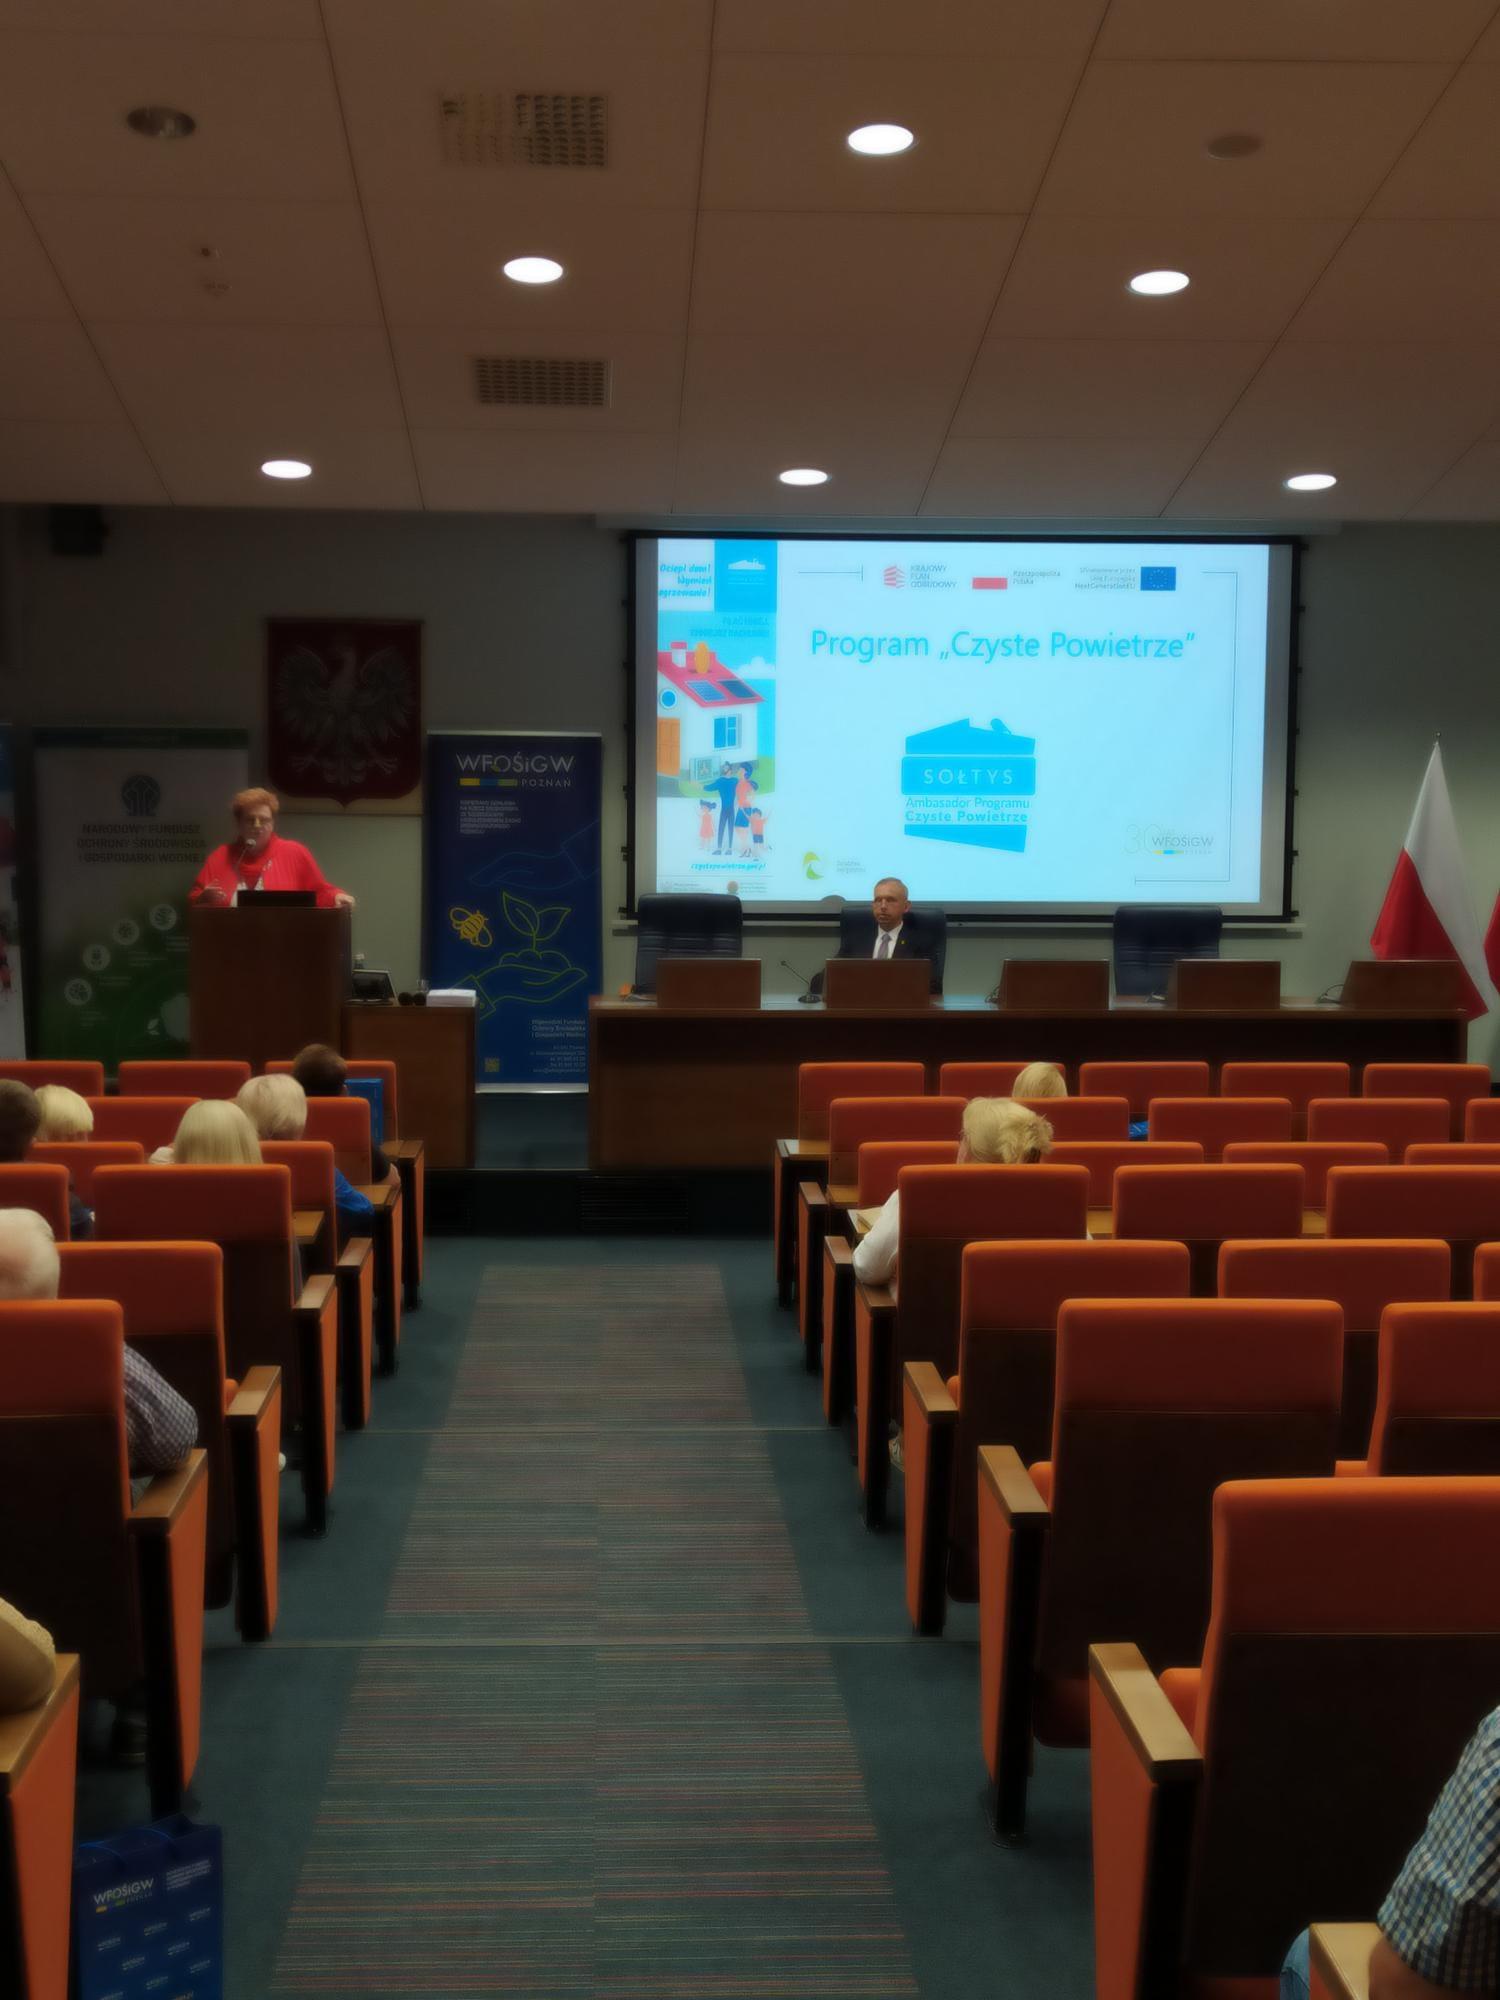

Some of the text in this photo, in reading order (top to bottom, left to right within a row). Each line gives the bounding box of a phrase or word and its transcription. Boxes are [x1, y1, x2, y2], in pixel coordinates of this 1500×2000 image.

[910, 564, 947, 573] KRAJOWY
[811, 630, 930, 663] Program
[939, 631, 1041, 664] „Czyste
[455, 751, 575, 773] WFOŚiGW
[520, 777, 572, 788] POZNAŃ
[923, 768, 1014, 785] SOŁTYS
[905, 797, 1030, 811] Ambasador Programu
[905, 810, 1029, 824] Czyste Powietrze
[81, 823, 201, 834] NARODOWY FUNDUSZ
[76, 838, 130, 849] OCHRONY
[83, 852, 156, 863] GOSPODARKI
